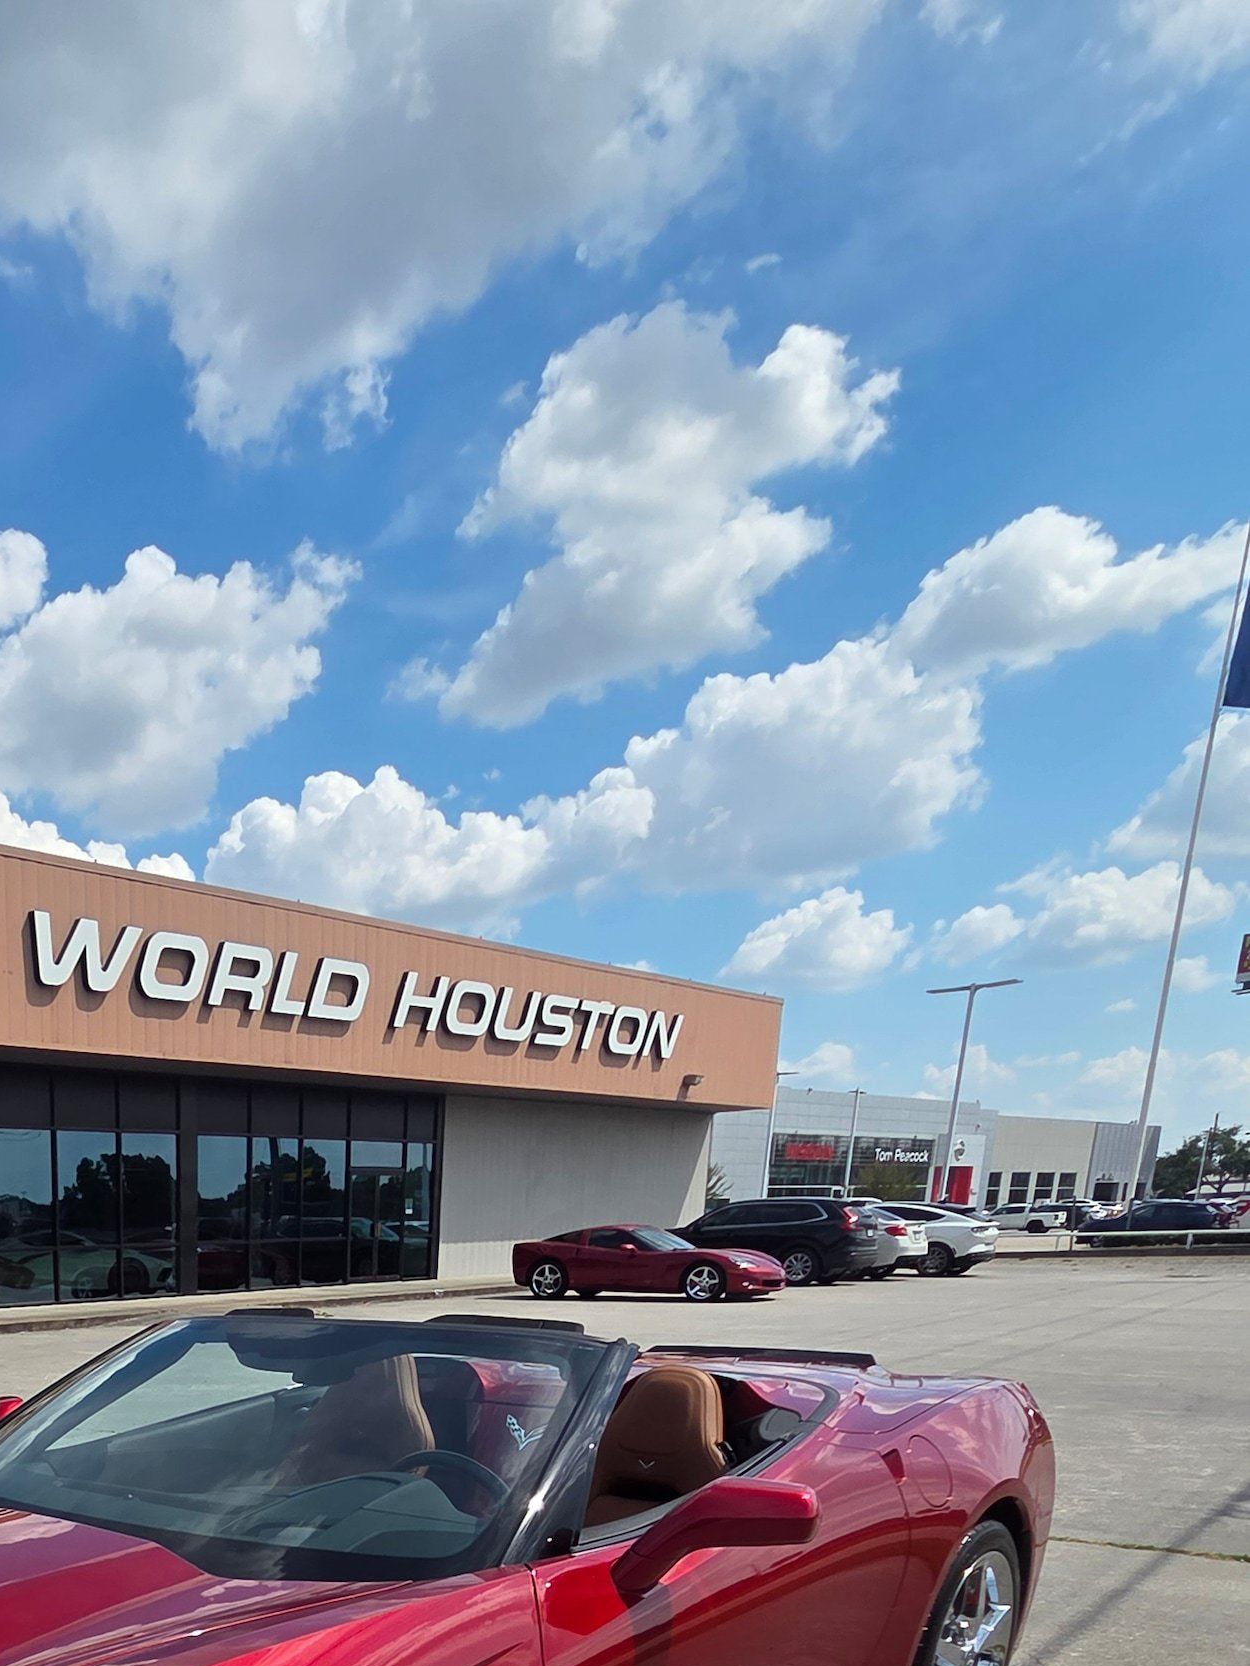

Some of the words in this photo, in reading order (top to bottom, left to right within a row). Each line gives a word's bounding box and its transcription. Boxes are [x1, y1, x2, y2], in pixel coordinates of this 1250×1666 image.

[32, 910, 370, 1021] WORLD
[394, 971, 683, 1058] HOUSTON
[874, 1148, 892, 1161] Tom
[894, 1148, 929, 1162] Peacock
